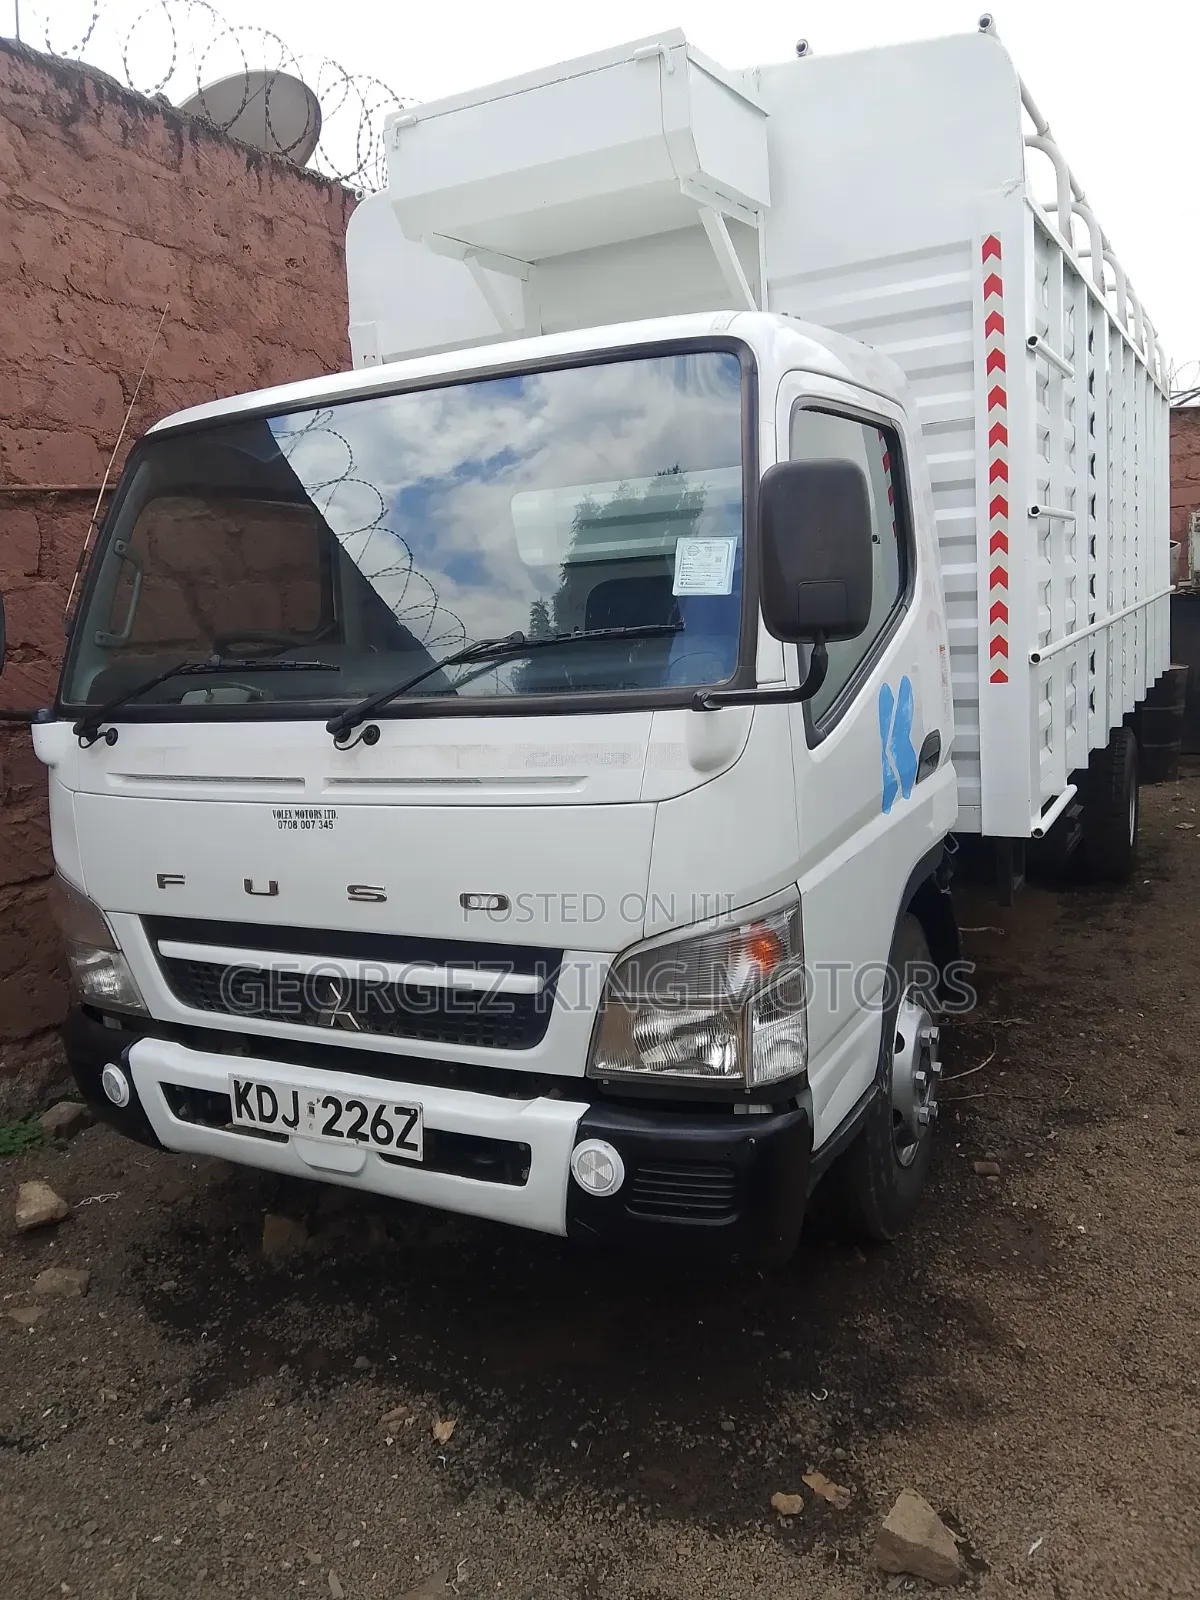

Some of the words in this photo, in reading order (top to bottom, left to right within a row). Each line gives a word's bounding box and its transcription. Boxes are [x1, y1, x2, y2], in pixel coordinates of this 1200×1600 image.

[272, 809, 293, 820] VOLEX
[294, 809, 322, 820] MOTORS
[323, 809, 339, 820] LTD.
[277, 820, 298, 830] 0708
[300, 820, 316, 830] 007
[318, 820, 334, 830] 345
[156, 873, 509, 911] FUSO
[233, 1080, 300, 1129] KDJ
[321, 1095, 419, 1152] 226Z
